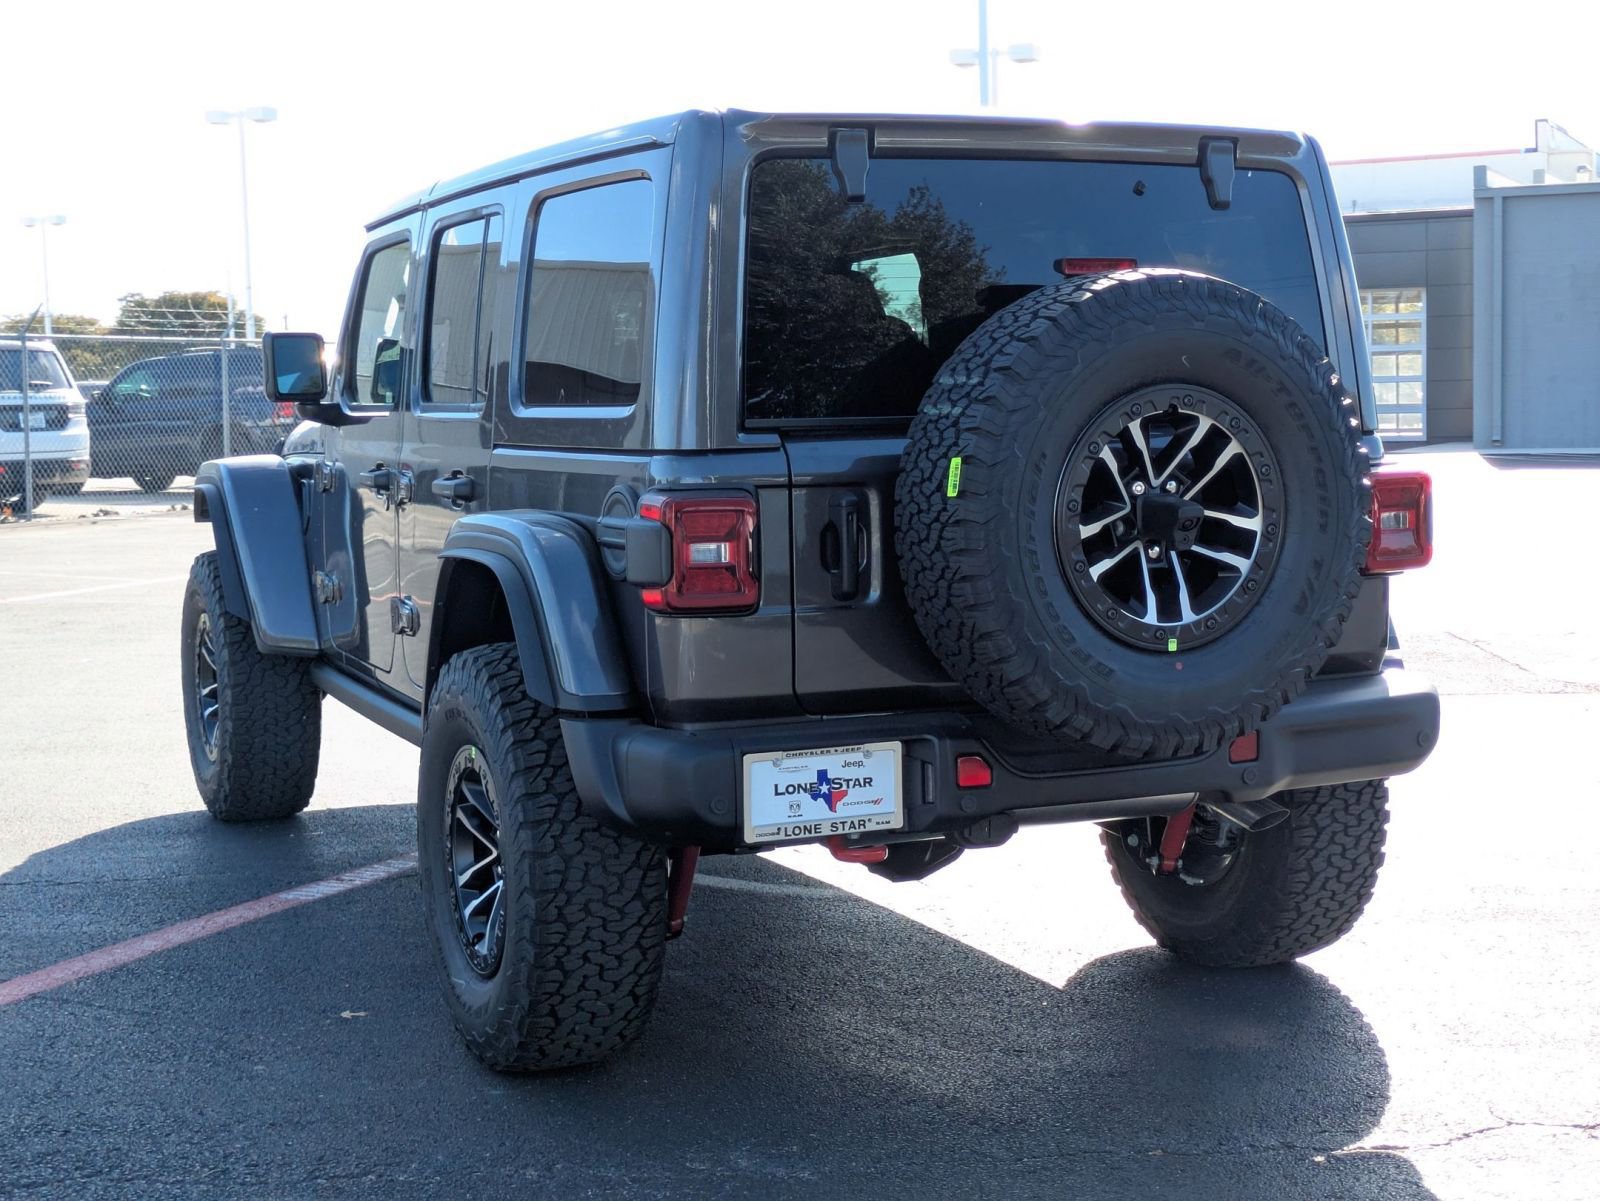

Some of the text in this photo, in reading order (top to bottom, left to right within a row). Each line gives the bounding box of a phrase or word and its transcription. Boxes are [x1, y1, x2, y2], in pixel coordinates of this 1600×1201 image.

[785, 749, 831, 758] CHRYSLER
[841, 760, 864, 768] Jeep
[774, 777, 873, 796] LONE STAR
[784, 823, 822, 837] LONE
[830, 819, 867, 832] STAR
